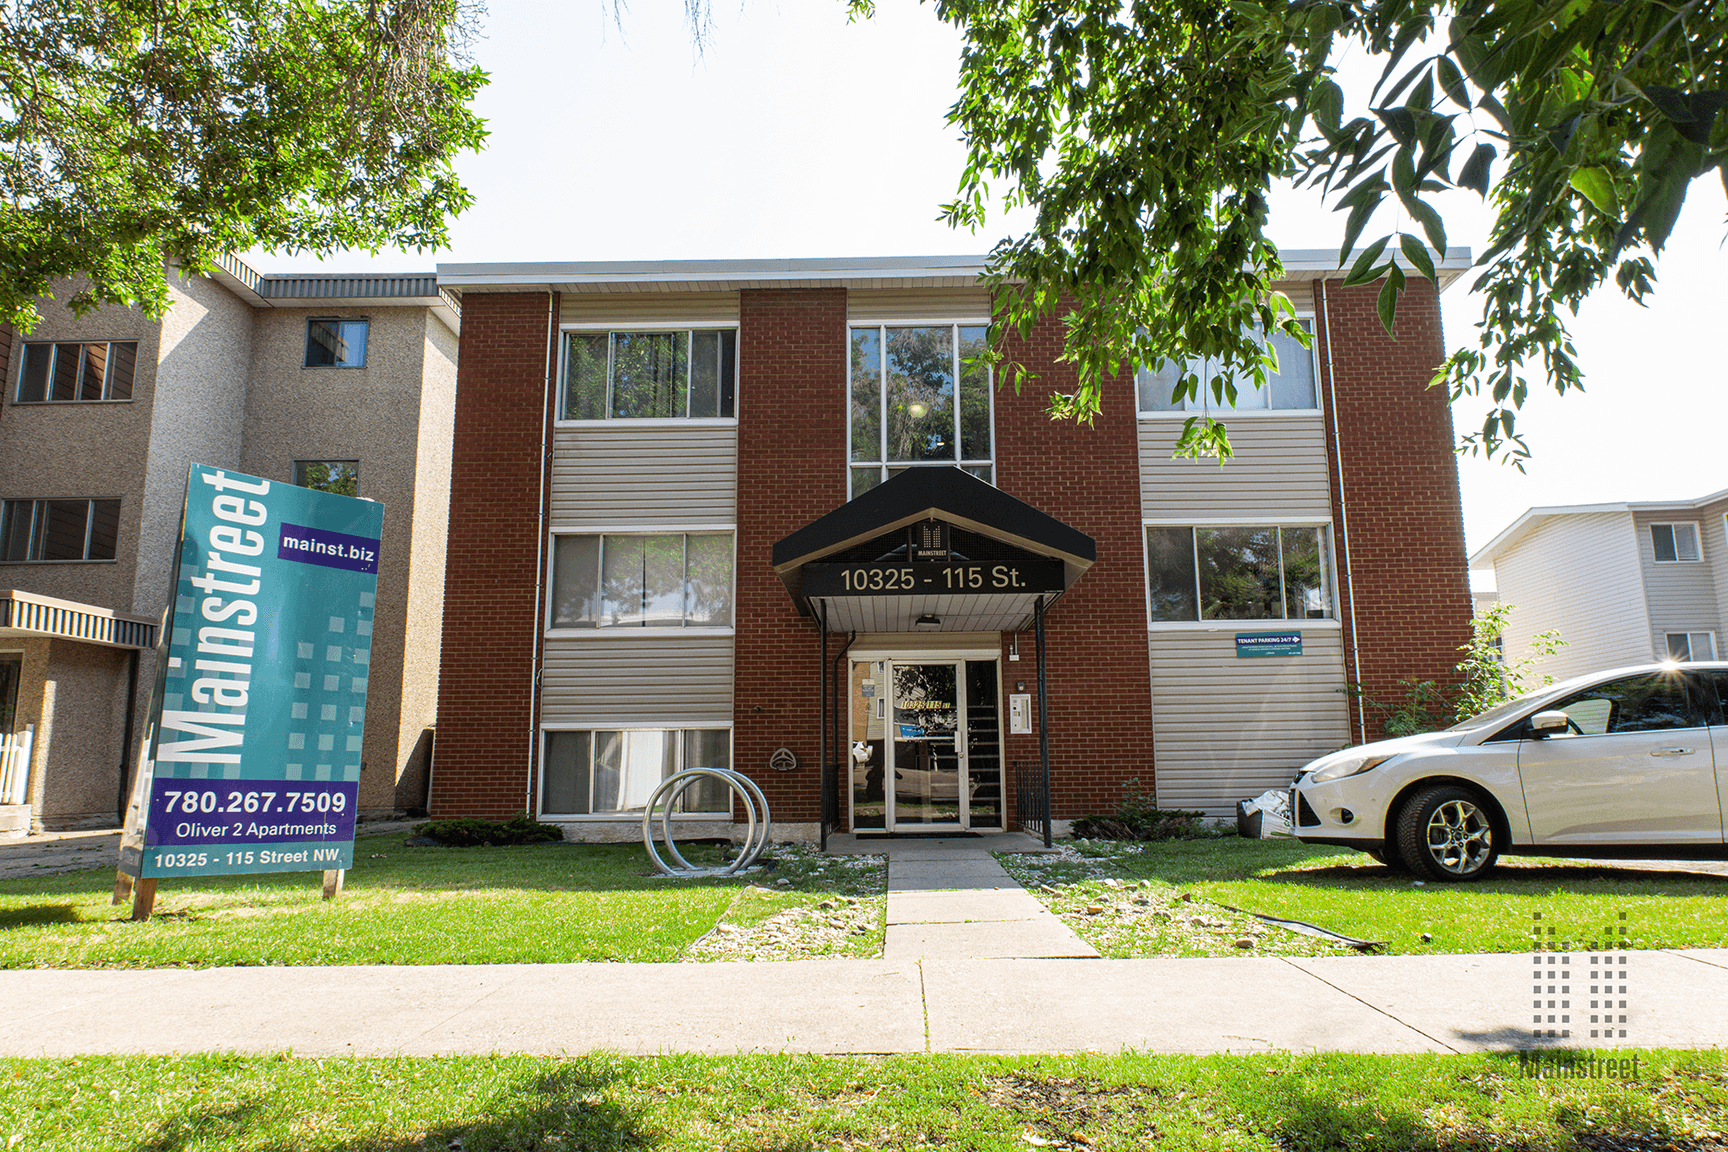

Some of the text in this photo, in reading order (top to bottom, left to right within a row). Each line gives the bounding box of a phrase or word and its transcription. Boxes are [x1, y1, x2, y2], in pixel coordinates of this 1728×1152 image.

[283, 536, 375, 562] mainst.biz
[841, 568, 915, 590] 10325
[943, 567, 983, 588] 115
[992, 565, 1026, 588] St.
[158, 470, 270, 764] Mainstreet
[164, 791, 346, 813] 780.267.7509
[176, 822, 337, 838] Oliver 2 Apartments
[155, 852, 208, 868] 10325
[226, 851, 254, 865] 115
[259, 849, 308, 863] Street
[313, 848, 339, 861] NW
